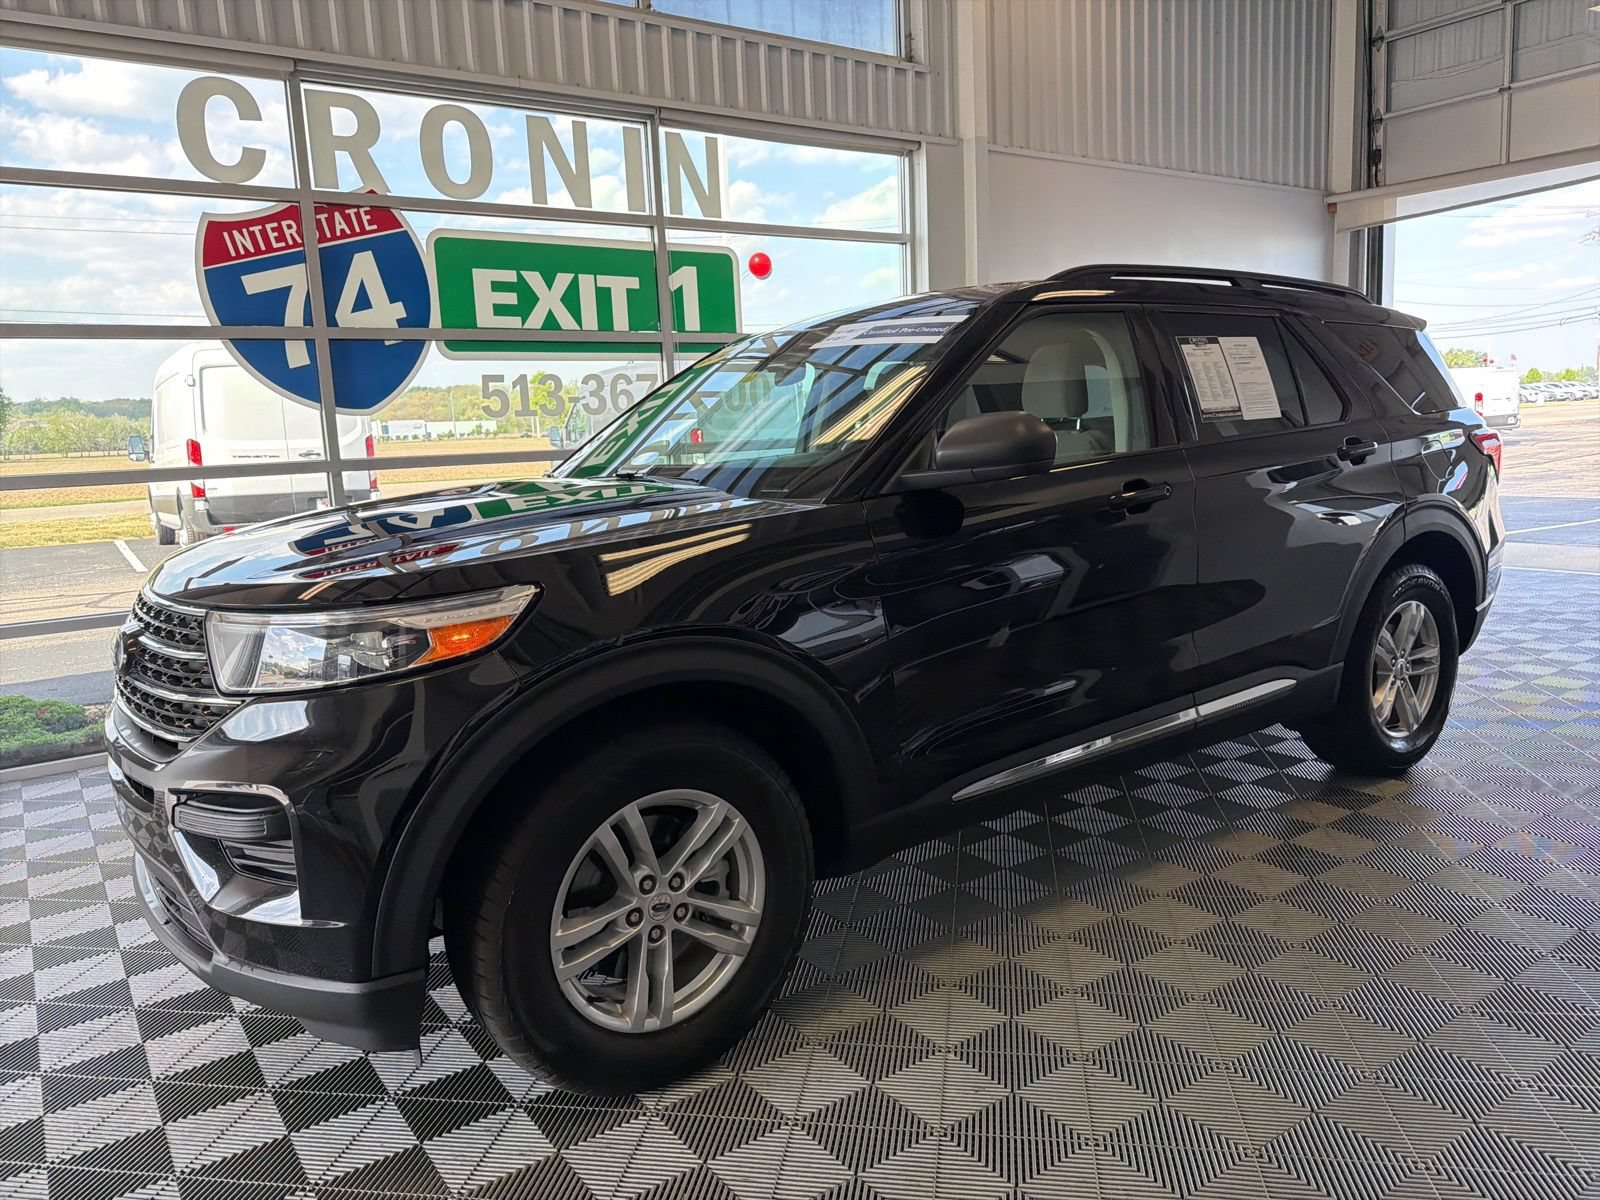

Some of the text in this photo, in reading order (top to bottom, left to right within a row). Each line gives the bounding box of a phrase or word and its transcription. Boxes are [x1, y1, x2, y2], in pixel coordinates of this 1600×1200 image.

[176, 76, 722, 219] CRONIN
[223, 206, 378, 258] INTERTATE
[240, 250, 408, 370] 74
[471, 265, 699, 332] EXIT 1
